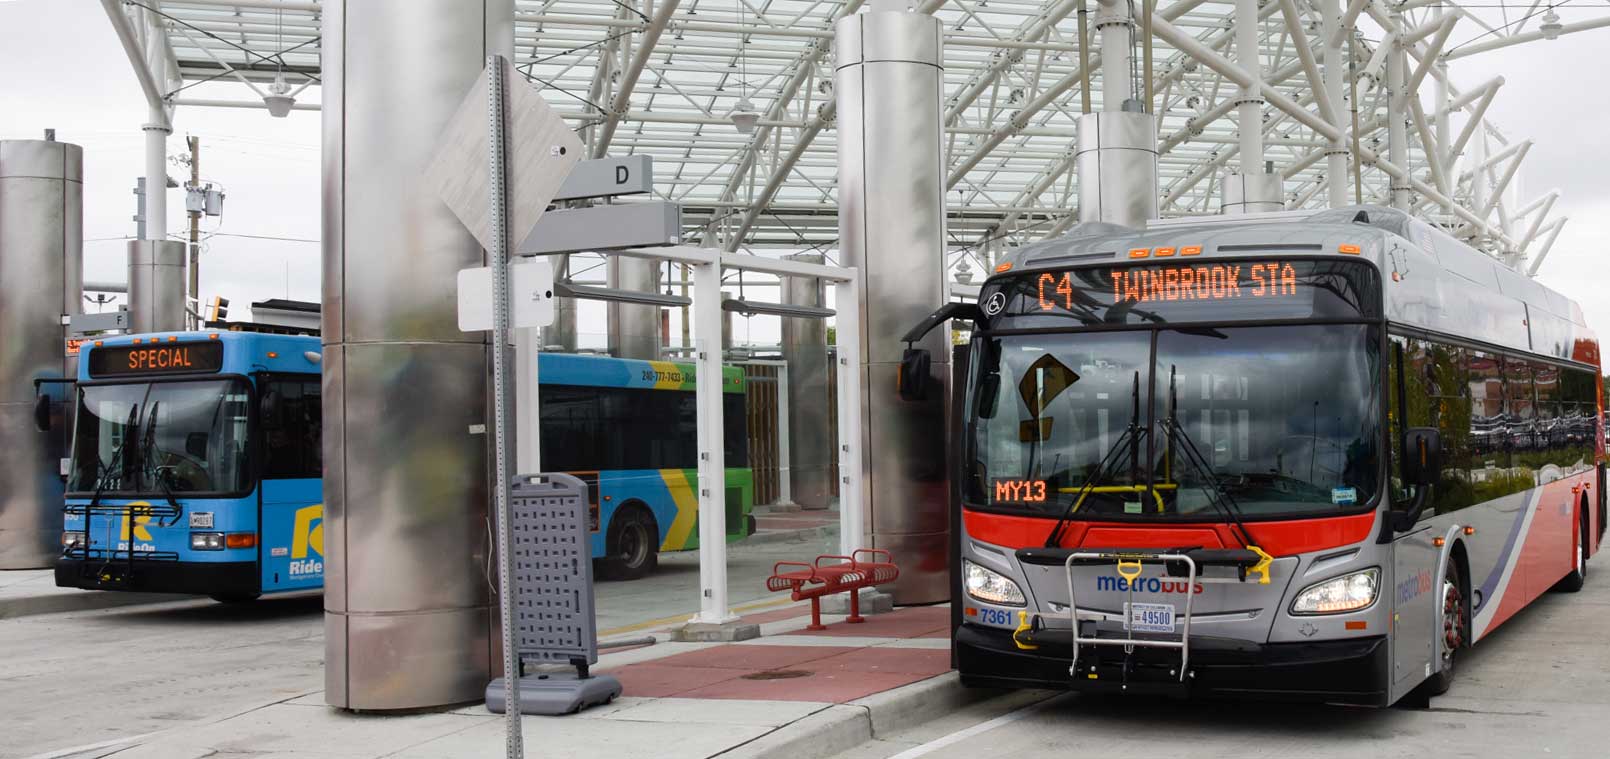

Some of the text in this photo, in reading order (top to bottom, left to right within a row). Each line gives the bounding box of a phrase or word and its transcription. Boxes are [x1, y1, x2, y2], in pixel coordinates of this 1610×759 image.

[616, 166, 629, 184] D
[1038, 263, 1296, 310] C4 TWINBROOK STA
[117, 315, 122, 325] F
[128, 348, 191, 368] SPECIAL
[996, 480, 1046, 501] MY13
[981, 608, 1011, 624] 7361
[1142, 611, 1170, 625] 49500
